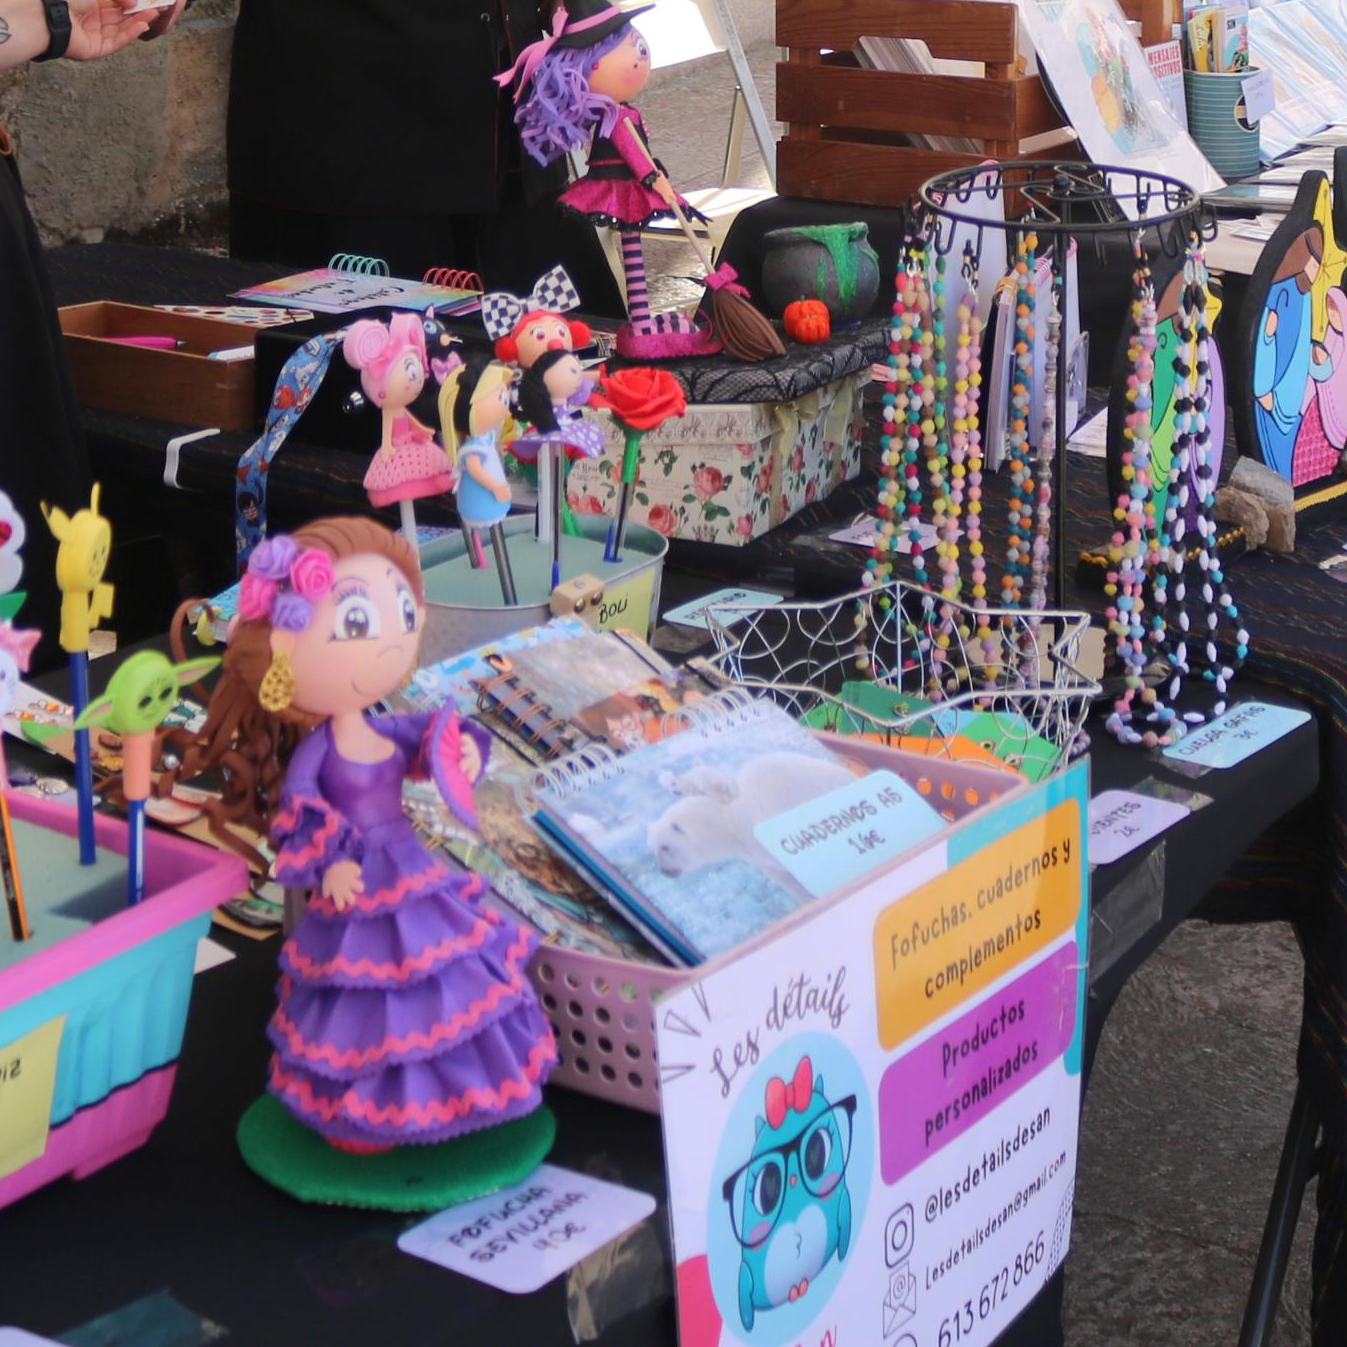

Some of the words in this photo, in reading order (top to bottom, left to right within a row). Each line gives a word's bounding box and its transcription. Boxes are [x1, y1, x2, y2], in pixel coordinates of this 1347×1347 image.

[780, 799, 878, 855] CUADERNOS
[876, 786, 904, 809] A5
[977, 845, 1058, 911] cuadernos
[1063, 837, 1071, 864] y
[924, 909, 1042, 999] complementos
[709, 1025, 760, 1099] Les
[766, 966, 850, 1030] détails
[941, 999, 1025, 1079] Productos
[925, 1040, 1038, 1148] personalizados
[924, 1107, 1051, 1224] @lesdetailsdesan
[448, 1185, 552, 1249] FOFUCHA
[469, 1190, 588, 1264] SEVILLANA
[937, 1299, 974, 1347] 613
[979, 1267, 1010, 1321] 672
[1013, 1230, 1045, 1286] 866
